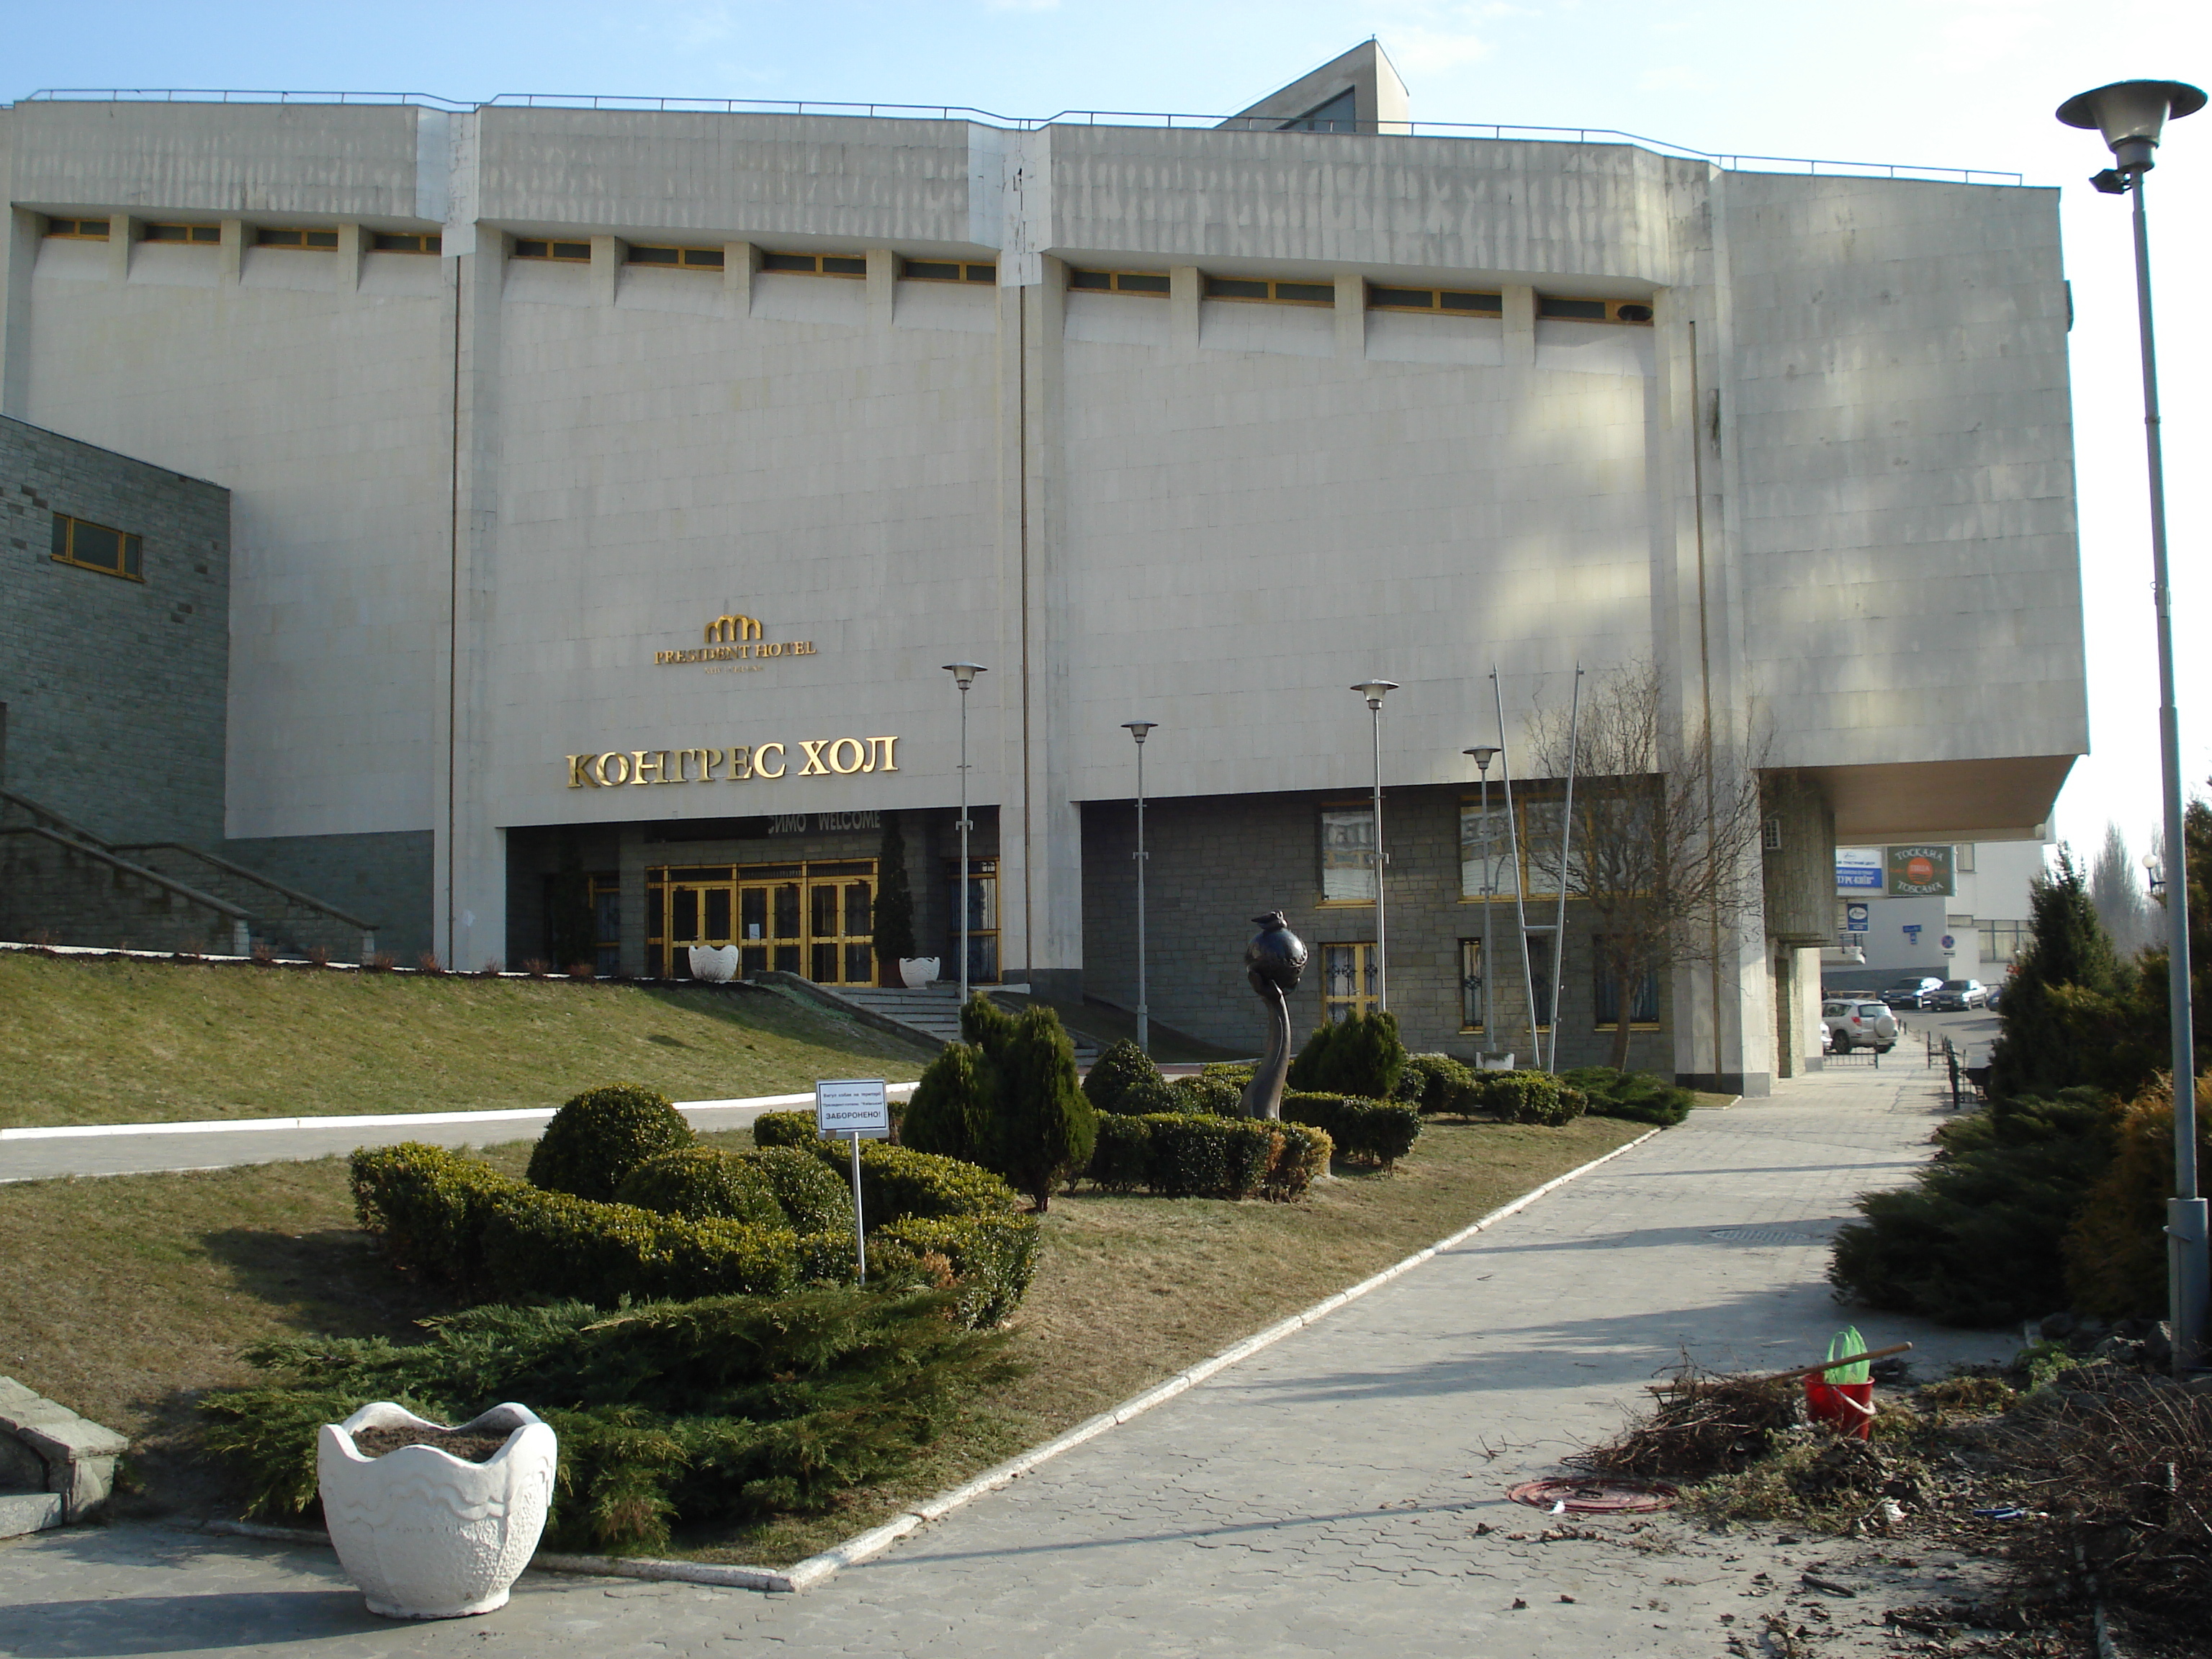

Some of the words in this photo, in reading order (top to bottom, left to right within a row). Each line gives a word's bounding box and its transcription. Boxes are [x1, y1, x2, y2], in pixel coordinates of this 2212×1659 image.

[654, 644, 750, 665] PRESIDENT
[755, 641, 817, 658] HOTEL
[565, 742, 786, 788] КОНГРЕС
[797, 735, 899, 776] ХОЛ
[818, 810, 881, 830] WELCOME
[1894, 848, 1943, 862] ТОСКАНА
[1897, 881, 1944, 894] TOSCANA
[826, 1111, 881, 1120] ЗАБОРОНЕНО!
